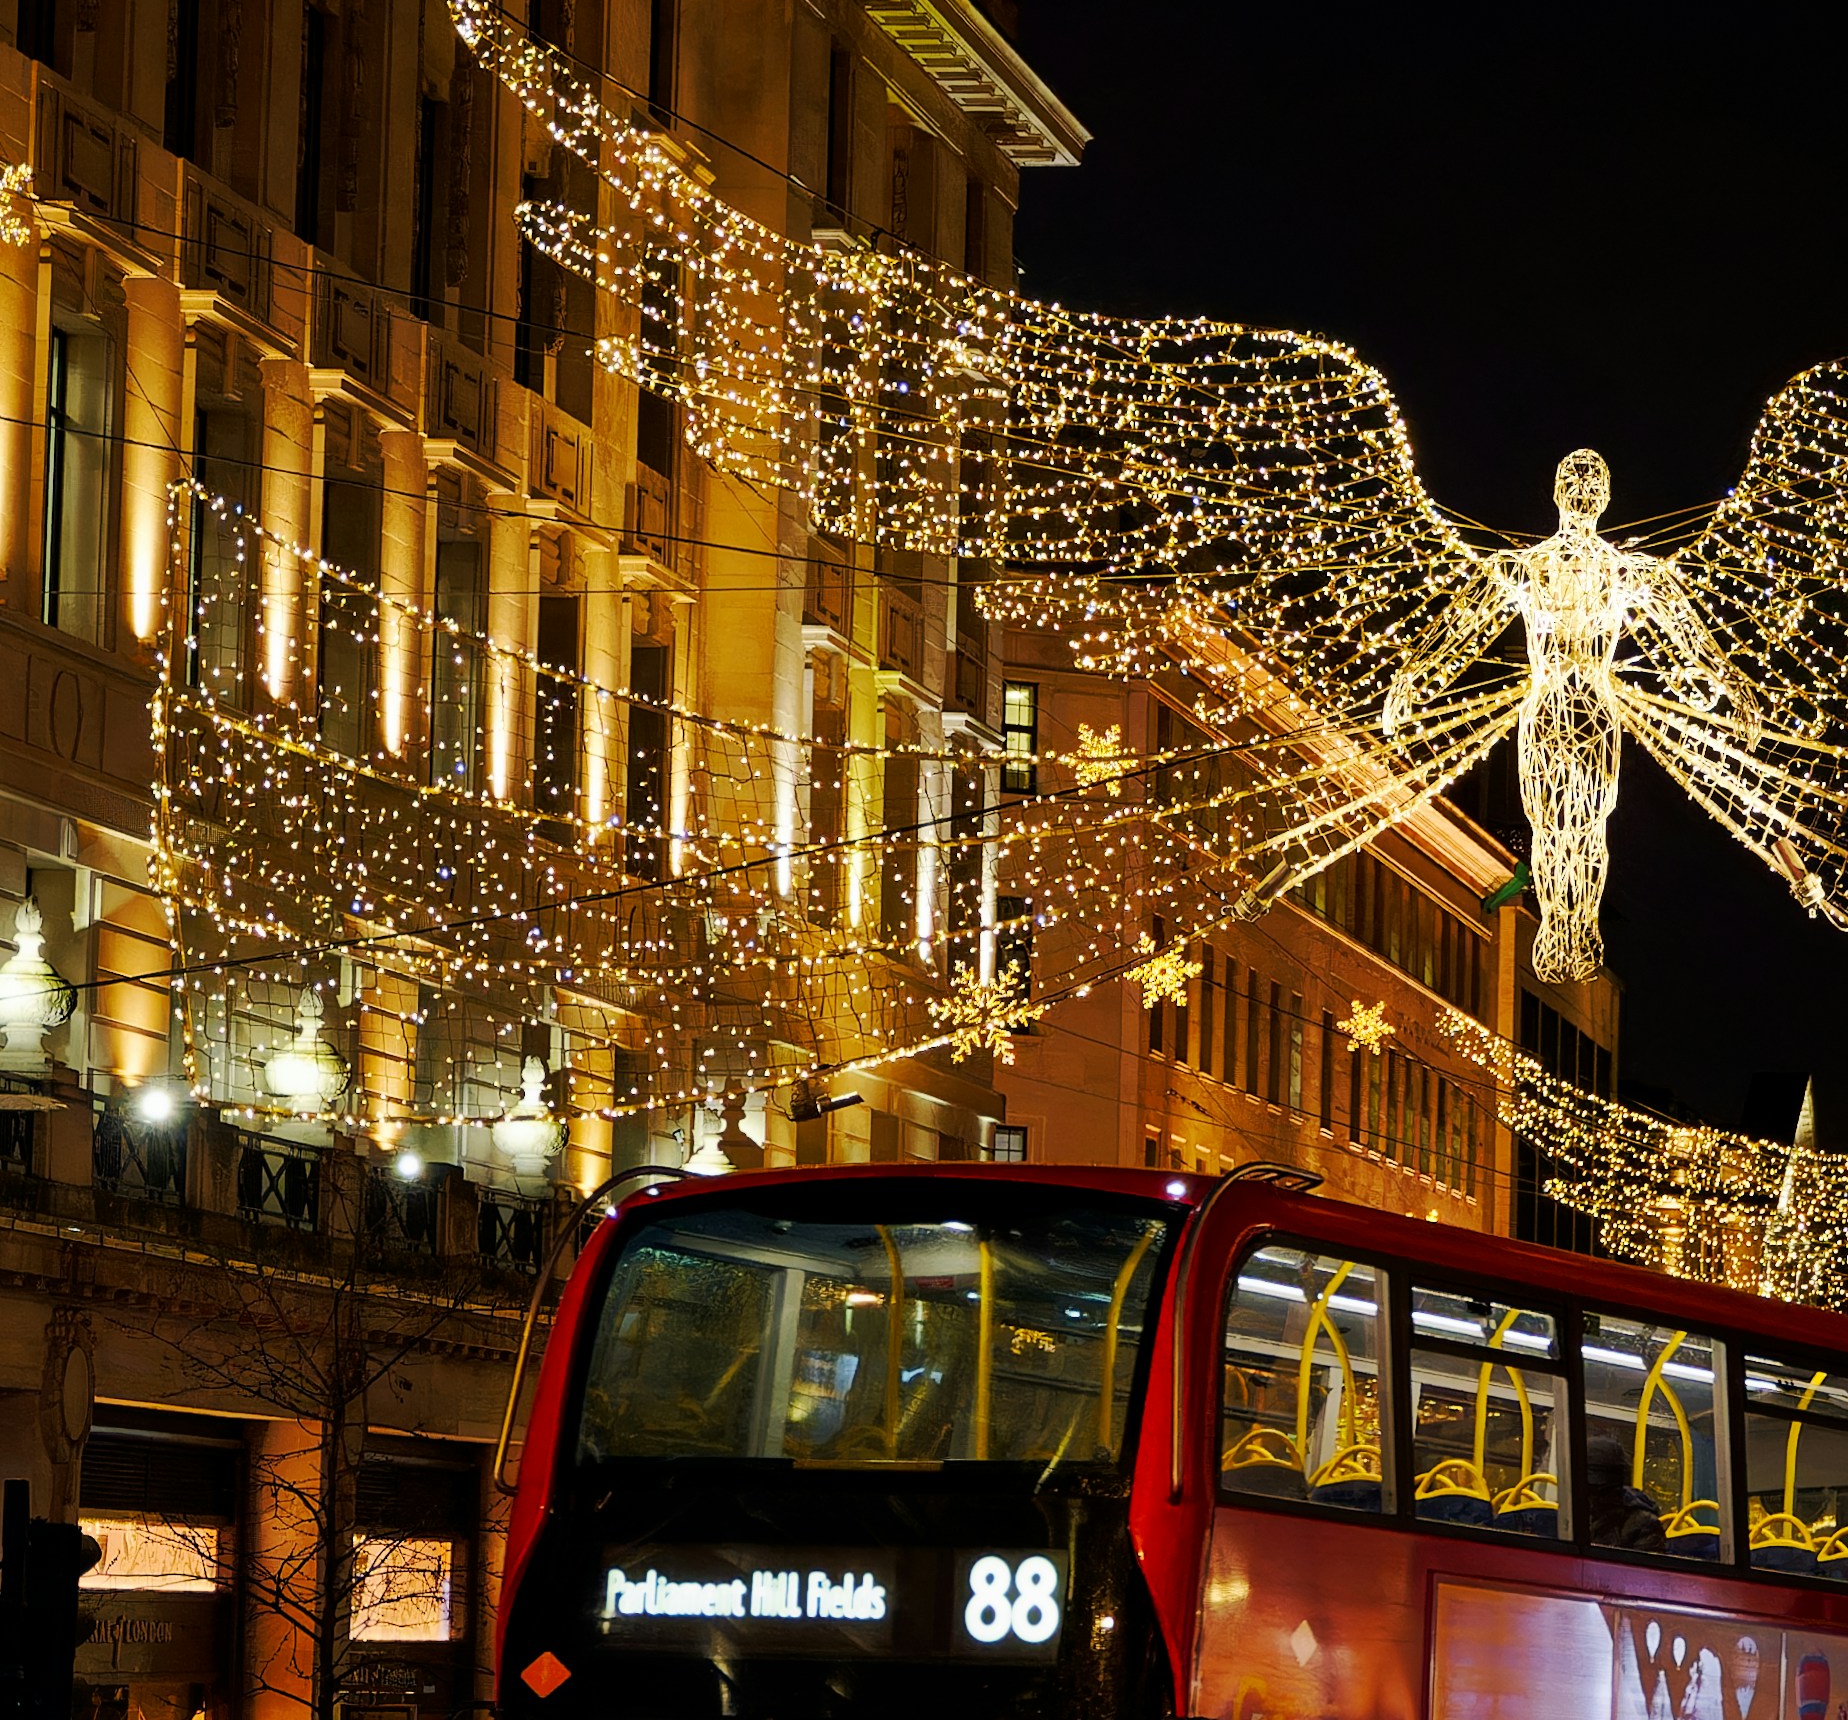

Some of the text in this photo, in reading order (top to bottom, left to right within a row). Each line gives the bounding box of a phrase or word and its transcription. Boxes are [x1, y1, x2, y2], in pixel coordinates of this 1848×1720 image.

[606, 1568, 886, 1620] Parliament Hill Fields
[964, 1555, 1060, 1643] 88
[126, 1620, 173, 1644] LONDON
